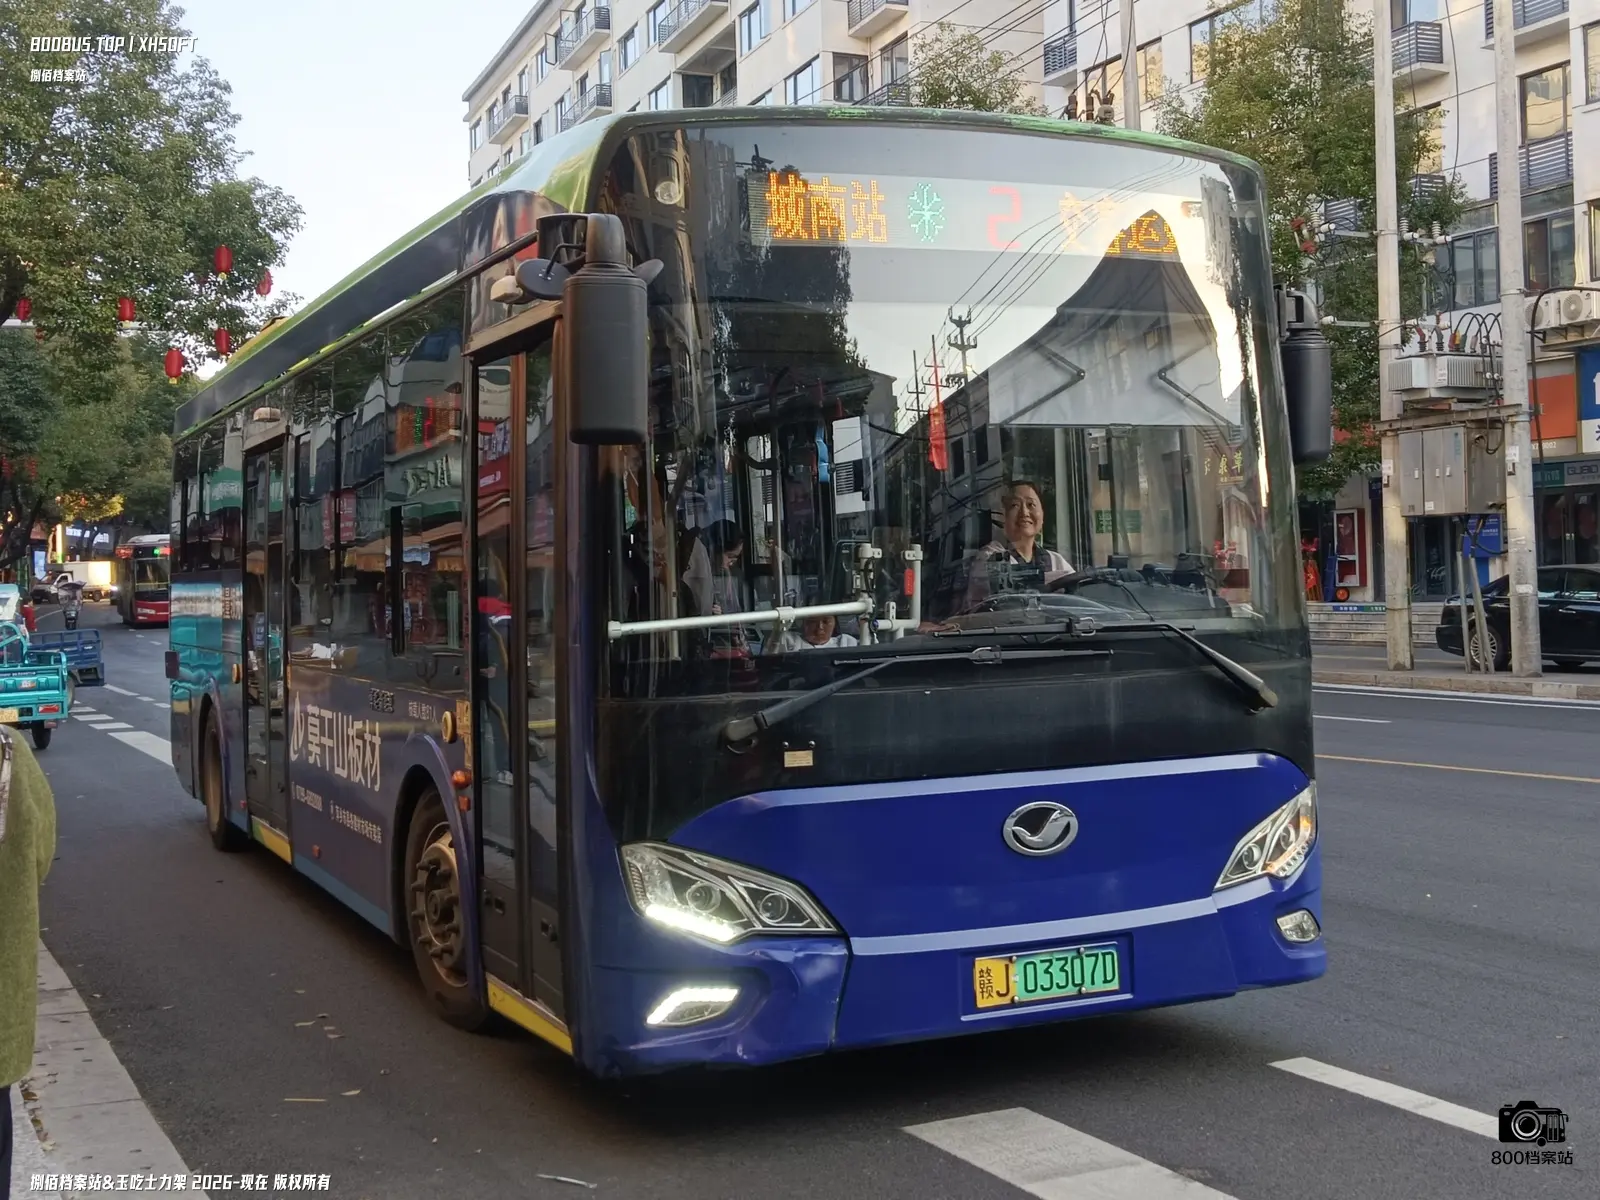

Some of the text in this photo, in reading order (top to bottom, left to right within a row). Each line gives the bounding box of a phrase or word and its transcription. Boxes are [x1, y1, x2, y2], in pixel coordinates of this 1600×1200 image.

[766, 172, 888, 242] 城南站
[987, 186, 1022, 249] 2
[306, 704, 381, 792] 莫干山板材
